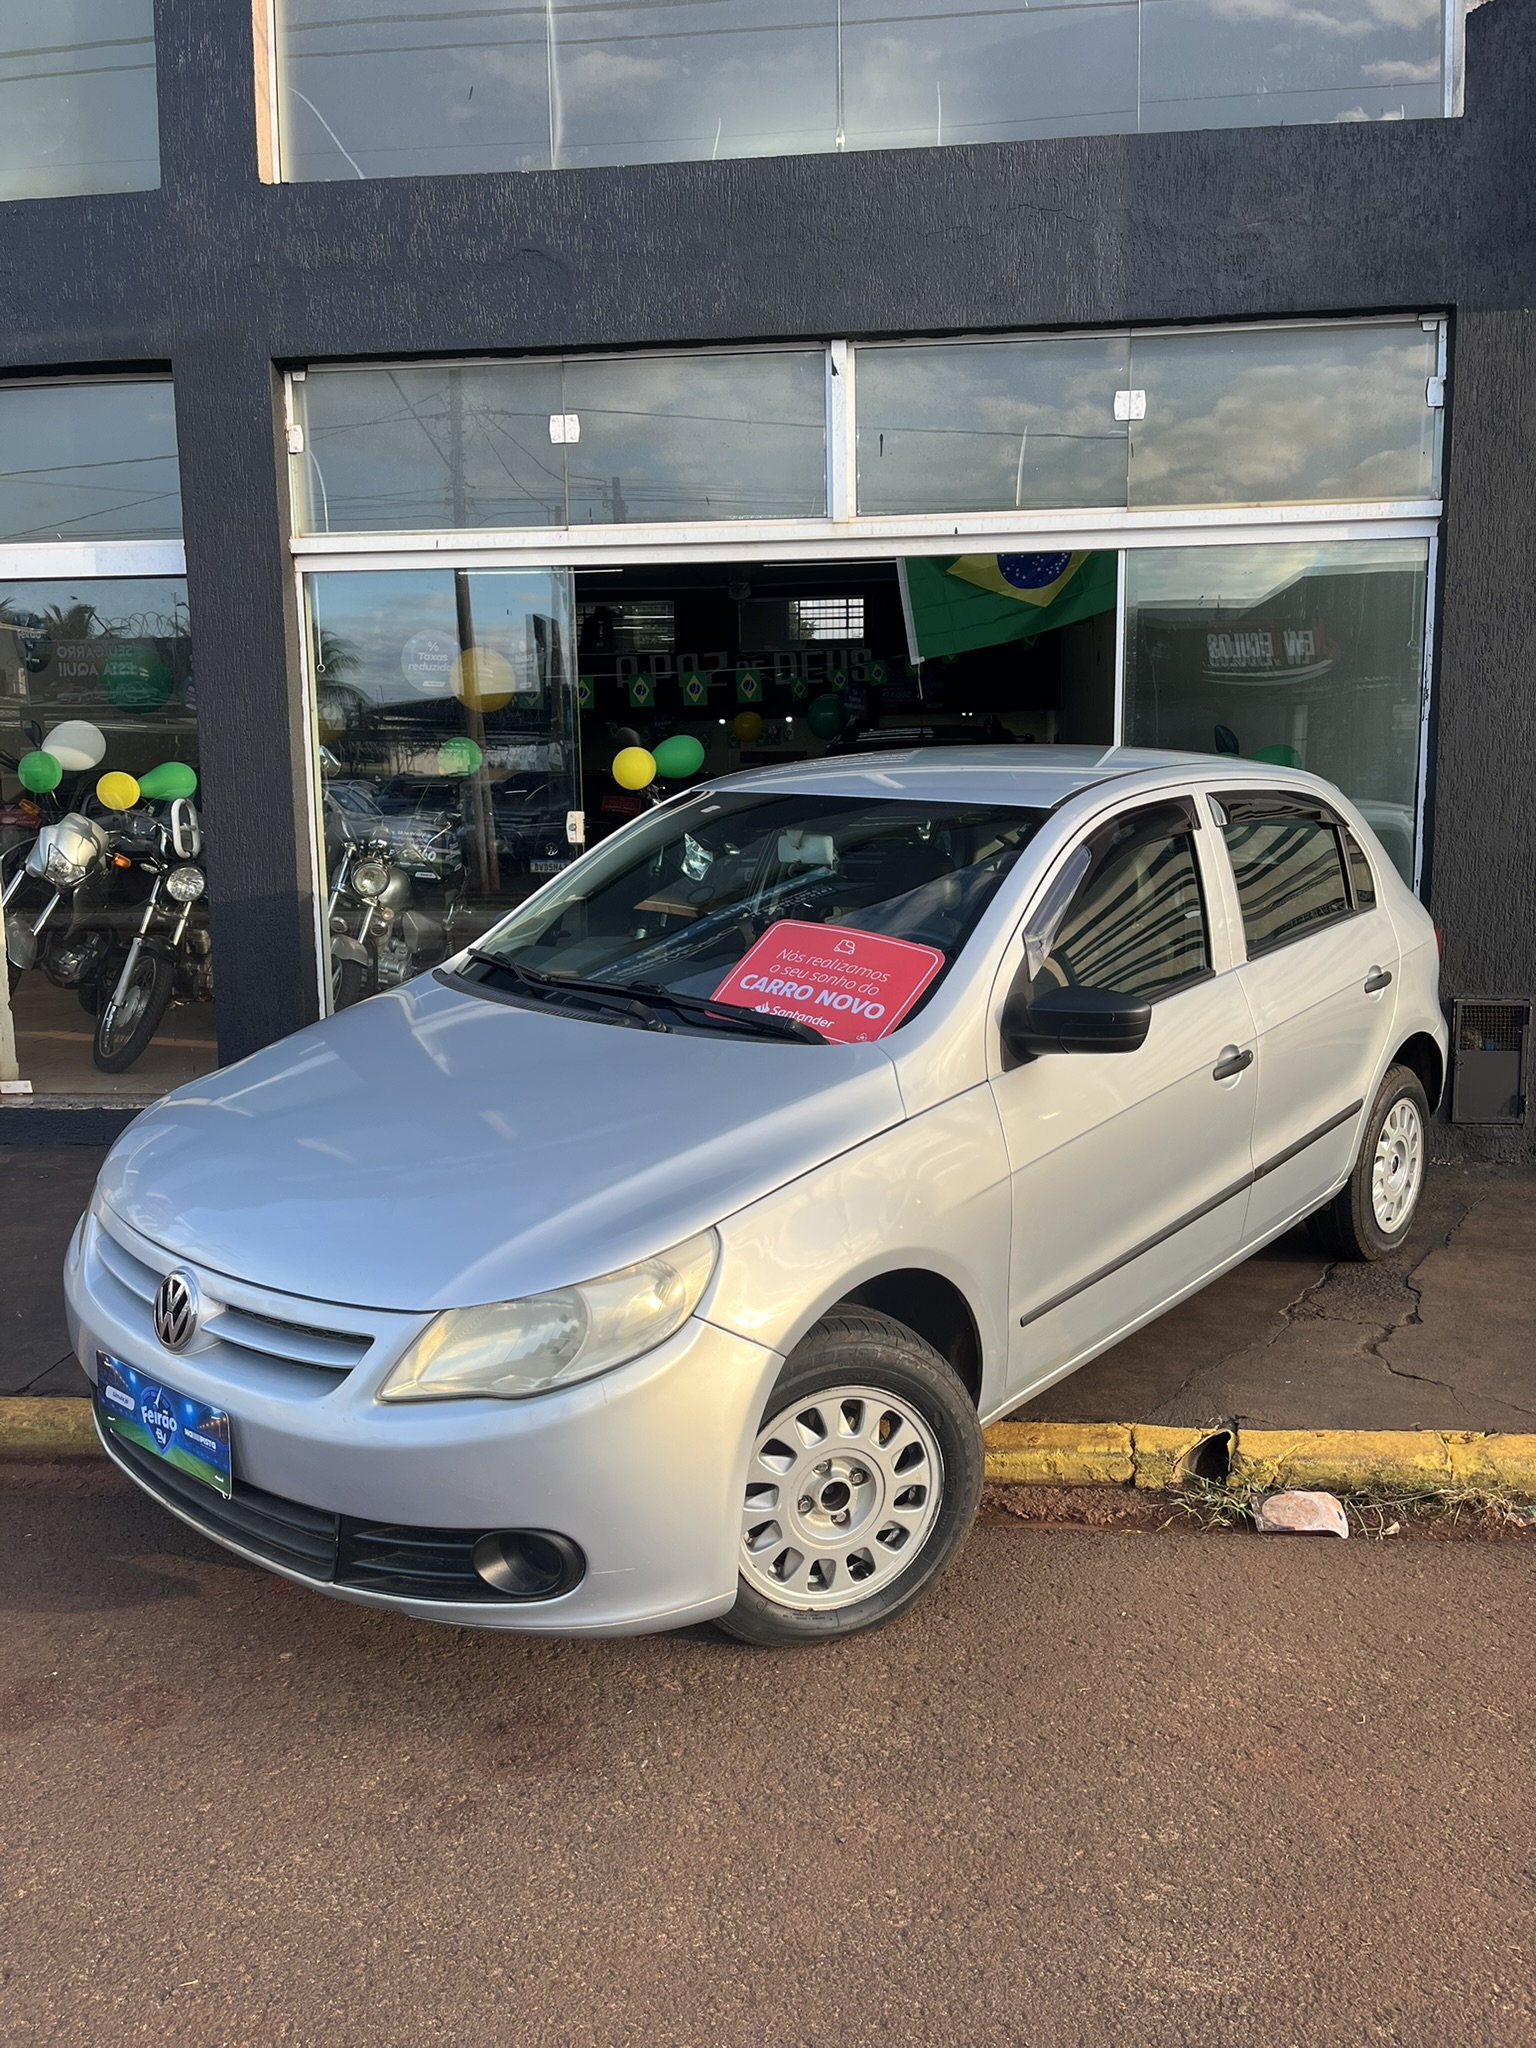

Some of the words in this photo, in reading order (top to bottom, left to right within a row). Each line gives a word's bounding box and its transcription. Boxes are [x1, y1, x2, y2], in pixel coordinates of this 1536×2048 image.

[418, 652, 449, 662] Taxas
[649, 651, 728, 688] PAZ
[773, 648, 873, 686] DEUS
[769, 963, 781, 974] o
[780, 964, 810, 979] seu
[809, 971, 857, 990] sonho
[857, 982, 880, 996] do
[776, 948, 807, 963] Nós
[806, 955, 891, 983] realizamos
[739, 973, 814, 1001] CARRO
[814, 989, 886, 1020] NOVO
[769, 1005, 836, 1029] Santander
[141, 1405, 178, 1432] Feirão
